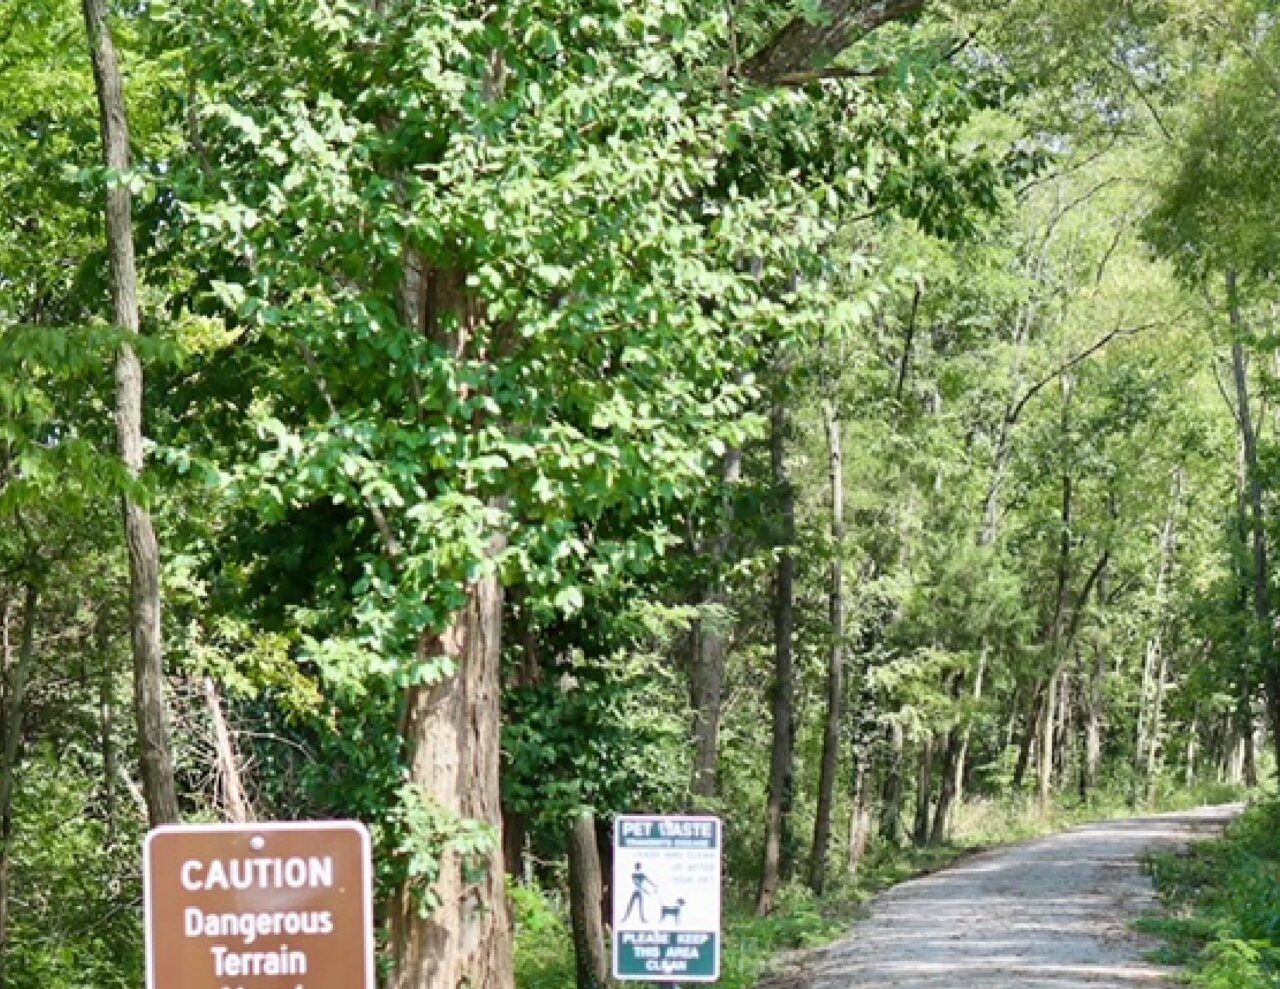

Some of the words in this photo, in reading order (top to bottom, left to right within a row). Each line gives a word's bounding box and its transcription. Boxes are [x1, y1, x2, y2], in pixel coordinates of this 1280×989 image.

[622, 821, 652, 837] PET
[658, 821, 713, 837] WASTE
[180, 856, 333, 891] CAUTION
[184, 906, 334, 944] Dangerous
[622, 932, 670, 945] PLEASE
[676, 932, 710, 945] KEEP
[210, 944, 307, 976] Terrain
[633, 946, 661, 958] THIS
[665, 946, 699, 958] AREA
[645, 959, 688, 972] CLEAN
